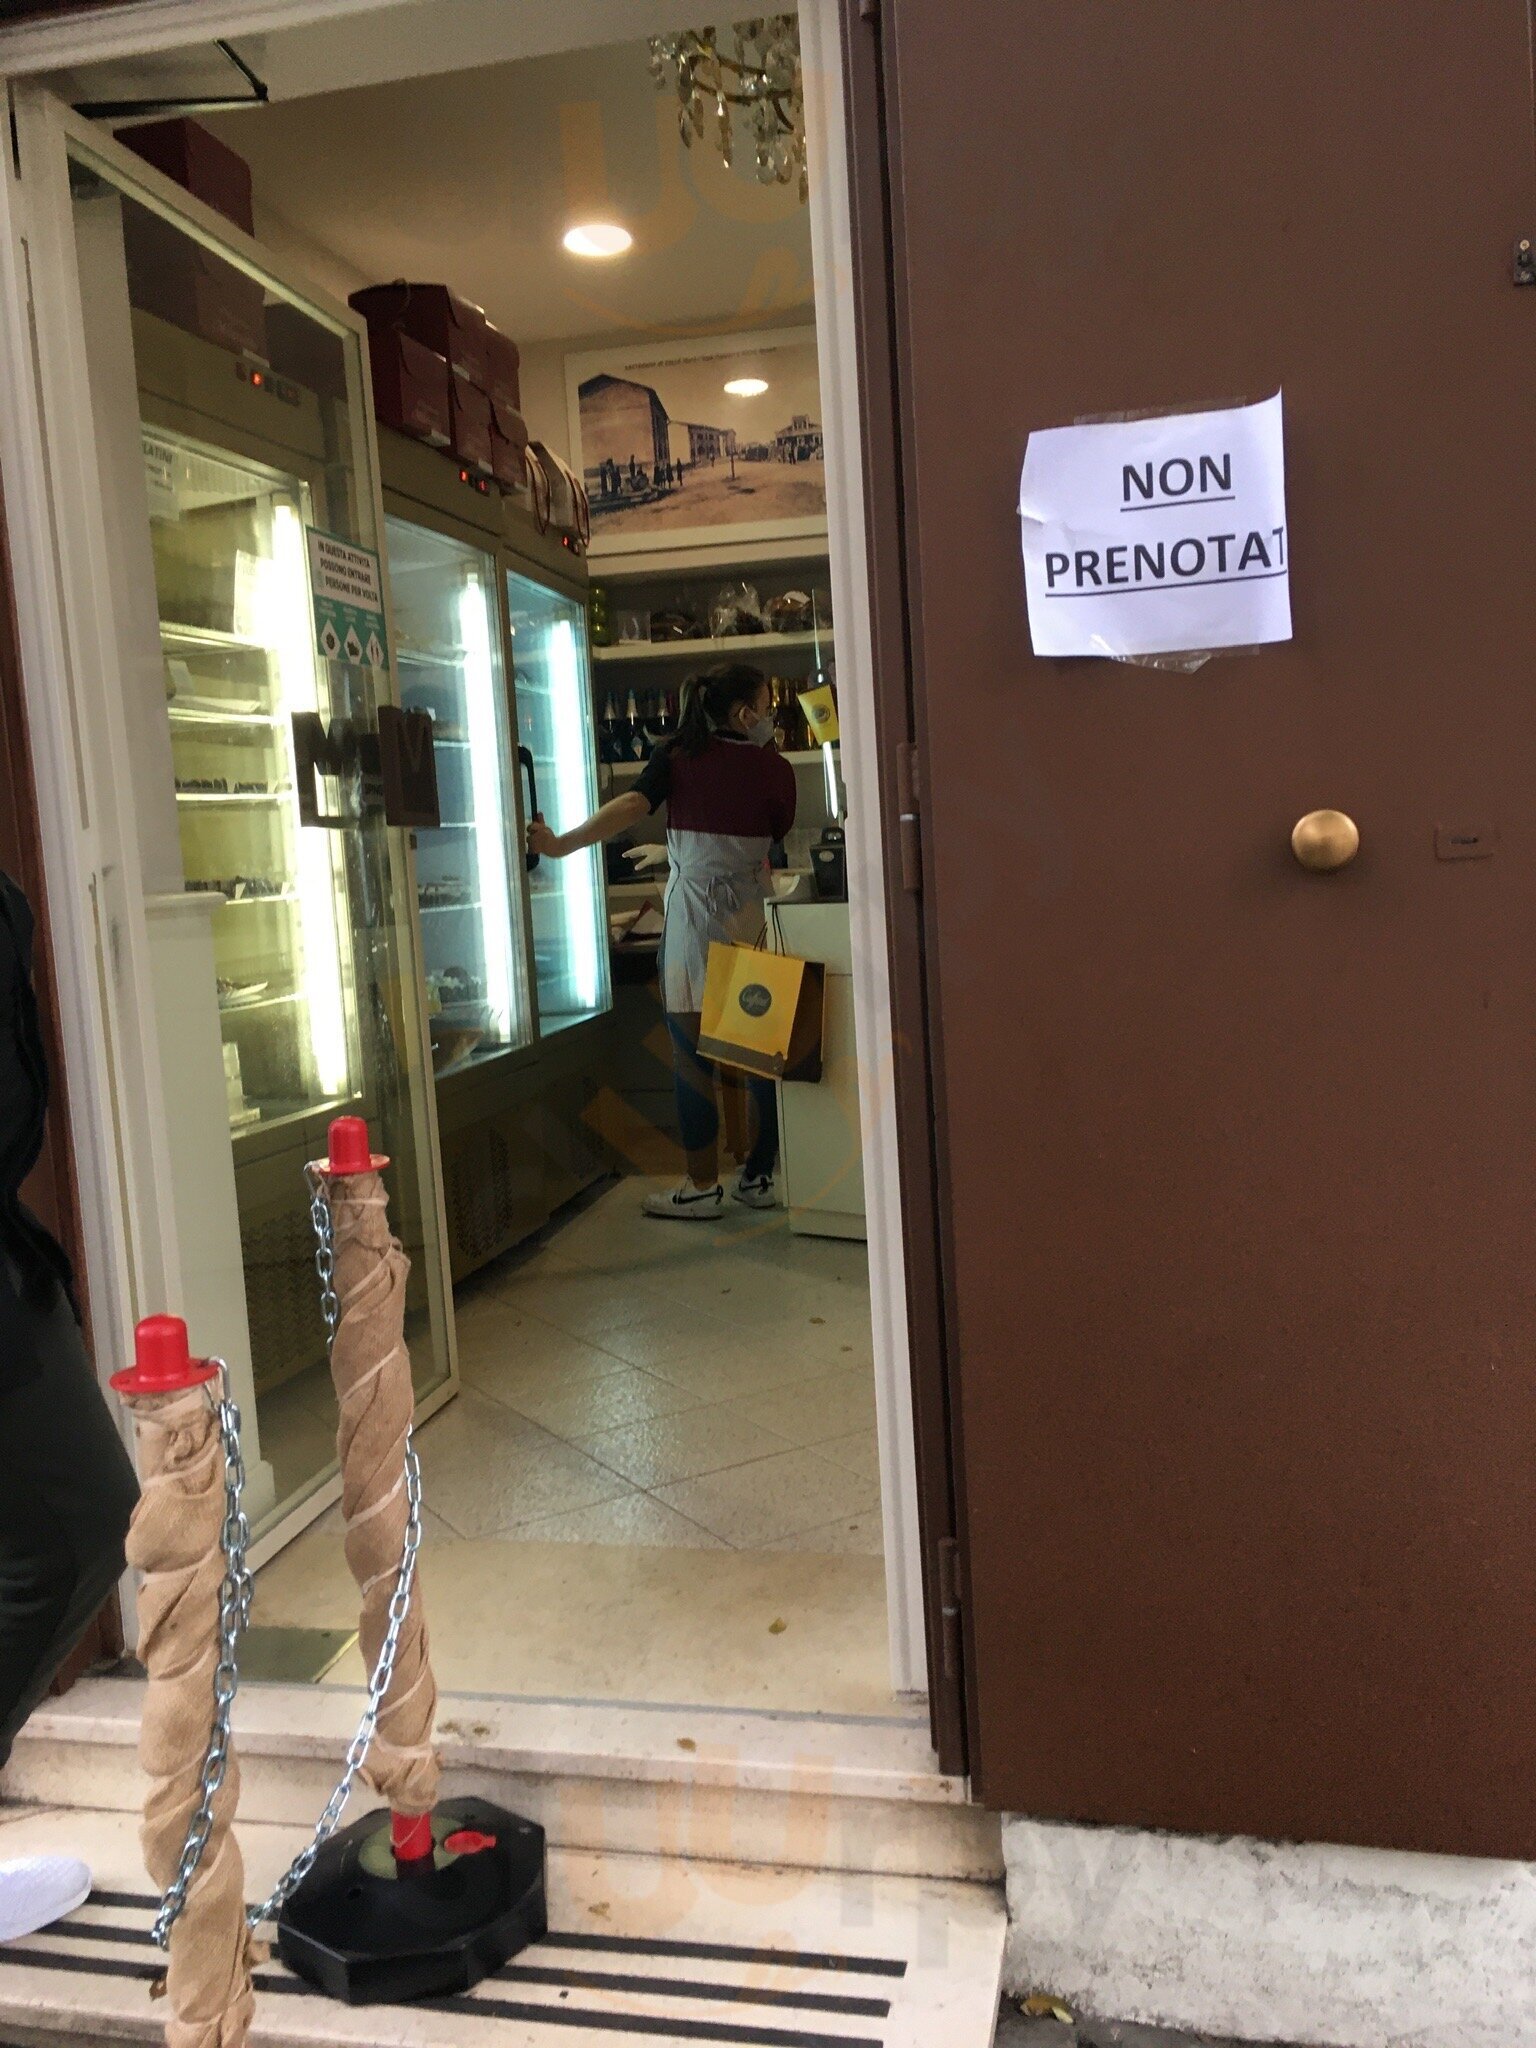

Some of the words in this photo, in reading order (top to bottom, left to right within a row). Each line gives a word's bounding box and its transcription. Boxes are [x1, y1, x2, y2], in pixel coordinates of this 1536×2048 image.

[1122, 453, 1232, 502] NON
[317, 540, 325, 552] IN
[325, 543, 347, 560] QUESTA
[320, 558, 346, 576] POSSONO
[347, 567, 371, 585] ENTRARE
[325, 576, 350, 593] PERSONE
[351, 585, 362, 596] PER
[362, 588, 378, 602] VOLTA
